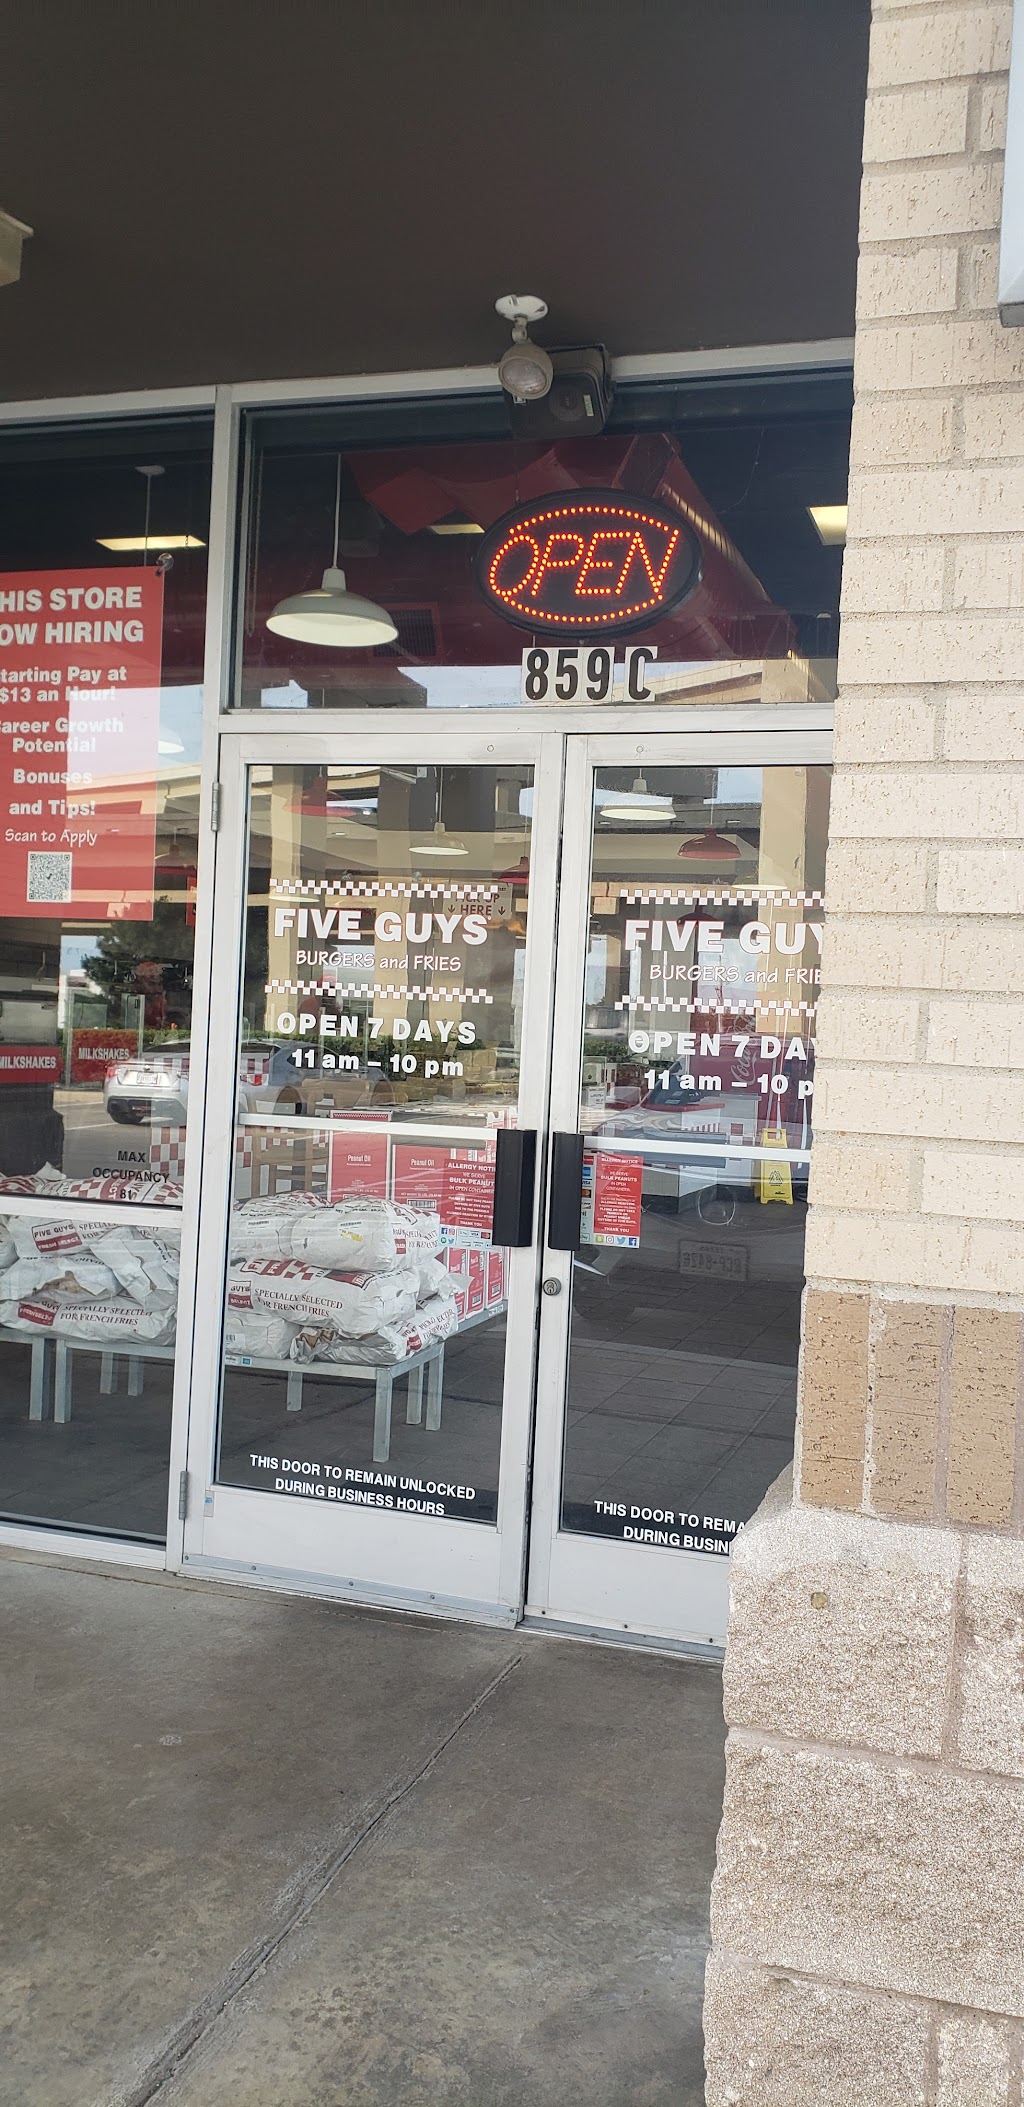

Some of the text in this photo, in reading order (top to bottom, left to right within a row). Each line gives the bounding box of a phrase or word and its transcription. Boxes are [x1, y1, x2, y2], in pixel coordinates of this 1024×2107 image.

[489, 530, 679, 597] OPEN
[49, 586, 142, 611] STORE
[45, 620, 143, 644] HIRING
[67, 666, 101, 684] Pay
[107, 666, 127, 681] at
[525, 647, 654, 700] 859 C
[0, 686, 116, 704] $13 an Hour!
[55, 717, 124, 733] Growth
[12, 737, 96, 752] Potential
[13, 768, 93, 784] Bonuses
[9, 799, 96, 818] and Tips!
[5, 828, 97, 847] Scan to Apply
[460, 904, 492, 916] HERE
[274, 908, 489, 945] FIVE GUYS
[625, 920, 725, 953] FIVE
[296, 950, 461, 971] BURGERS and FRIES
[650, 965, 739, 982] BURGERS
[744, 968, 778, 984] and
[277, 1013, 476, 1044] OPEN 7 DAYS
[78, 1047, 130, 1060] MILKSHAKES
[628, 1030, 816, 1061] OPEN 7 DA
[292, 1049, 315, 1068] 11
[322, 1054, 359, 1070] am
[390, 1053, 417, 1073] 10
[425, 1059, 464, 1079] pm
[644, 1070, 670, 1090] 11
[680, 1074, 721, 1091] am
[757, 1074, 789, 1094] 10
[117, 1150, 146, 1162] MAX
[92, 1167, 170, 1183] OCCUPANCY
[448, 1162, 477, 1170] ALLERGY
[33, 1224, 74, 1238] FIVE GUYS
[38, 1236, 79, 1250] FRESH SELECT
[255, 1288, 342, 1309] SPECIALLY SELECTED
[60, 1312, 139, 1326] FOR FRENCH FRIES
[273, 1301, 307, 1312] FRENCH
[308, 1307, 329, 1318] FRIES
[250, 1454, 475, 1500] THIS DOOR TO REMAIN UNLOCKED
[275, 1478, 445, 1516] DURING BUSINESS HOURS
[594, 1500, 626, 1517] THIS
[630, 1506, 674, 1524] DOOR
[678, 1513, 699, 1527] TO
[623, 1526, 680, 1546] DURING
